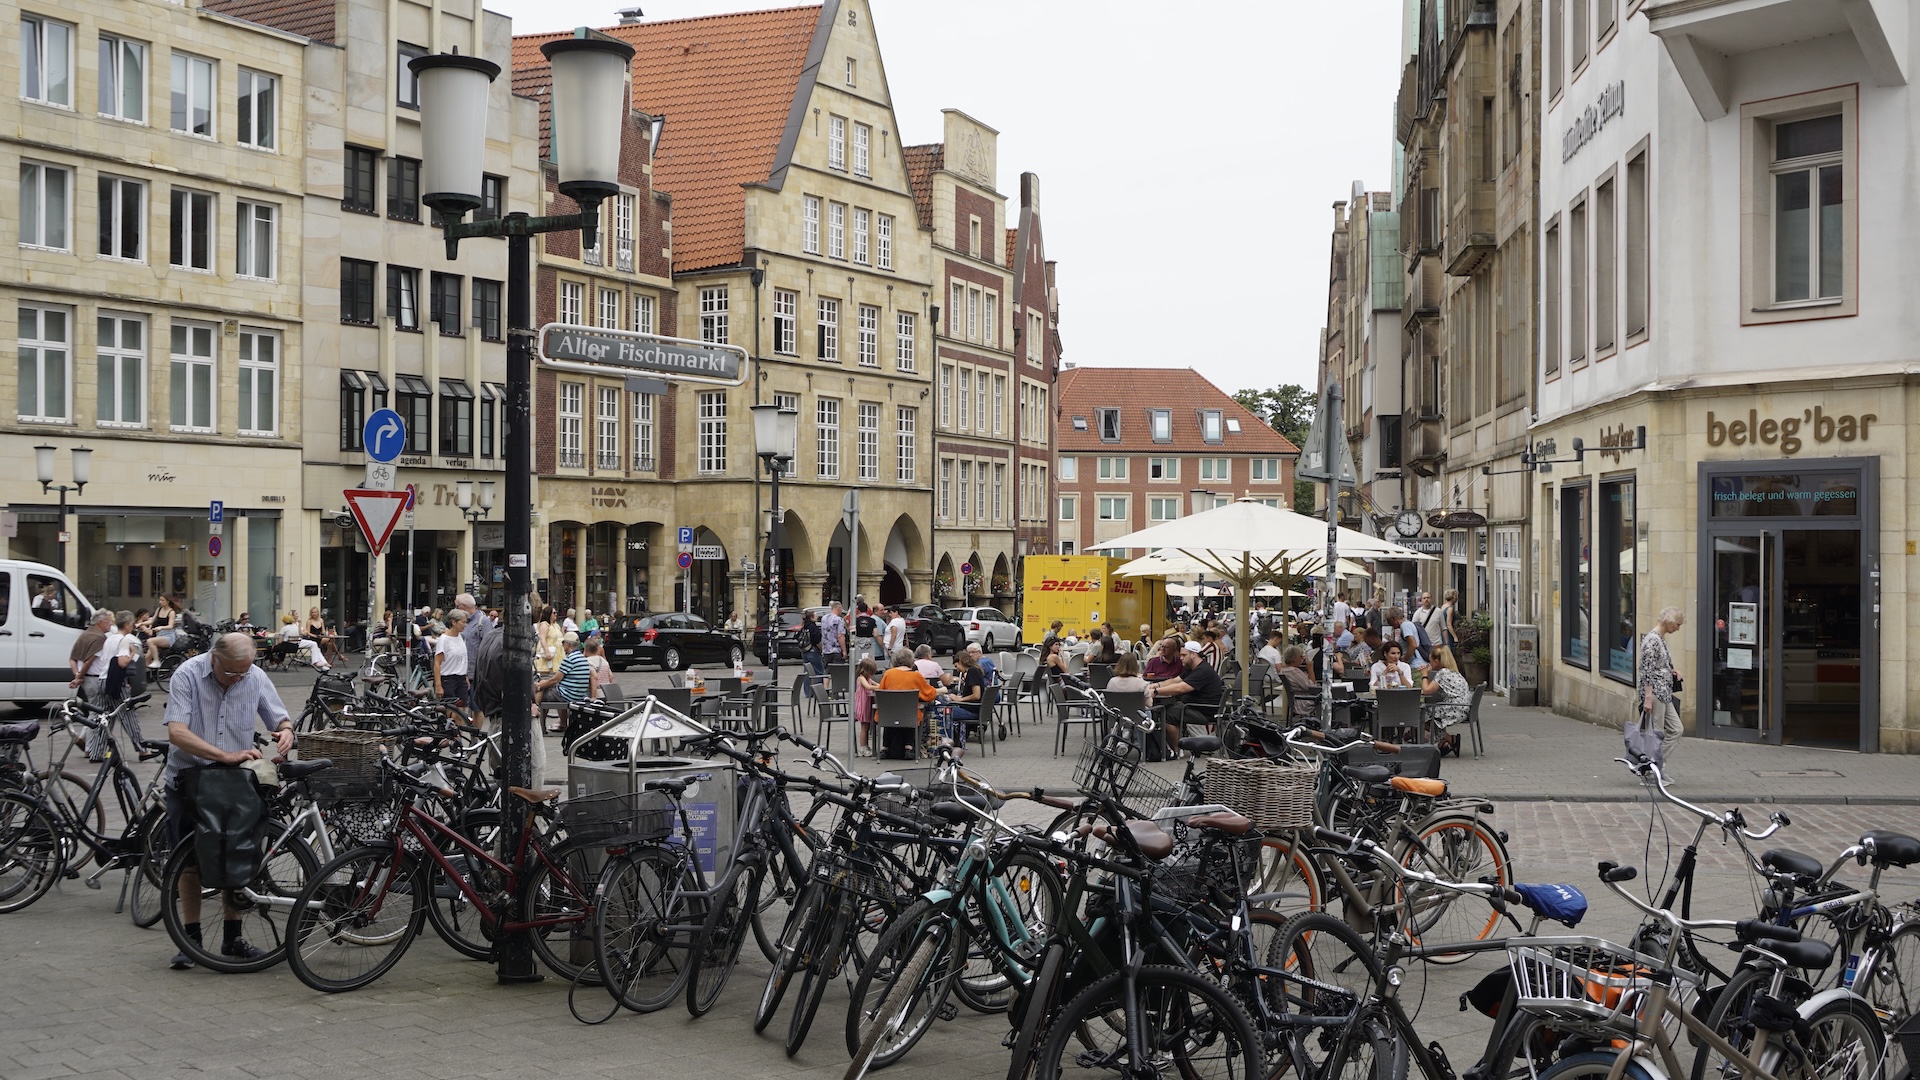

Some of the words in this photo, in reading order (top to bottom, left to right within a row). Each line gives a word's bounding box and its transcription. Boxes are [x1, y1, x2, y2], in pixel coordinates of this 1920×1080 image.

[618, 342, 727, 372] Fischmarkt
[400, 456, 427, 466] agenda
[445, 457, 468, 468] verlag
[591, 487, 627, 508] MOX
[1714, 490, 1738, 501] frisch
[1739, 490, 1766, 503] belegt
[1768, 489, 1785, 500] und
[1787, 491, 1812, 500] warm
[1813, 490, 1856, 502] gegessen
[628, 542, 646, 550] MOX
[1398, 541, 1444, 552] buschmann
[1040, 580, 1091, 592] DHL
[1113, 580, 1134, 594] DHL
[1291, 973, 1345, 993] ROCKRIDER
